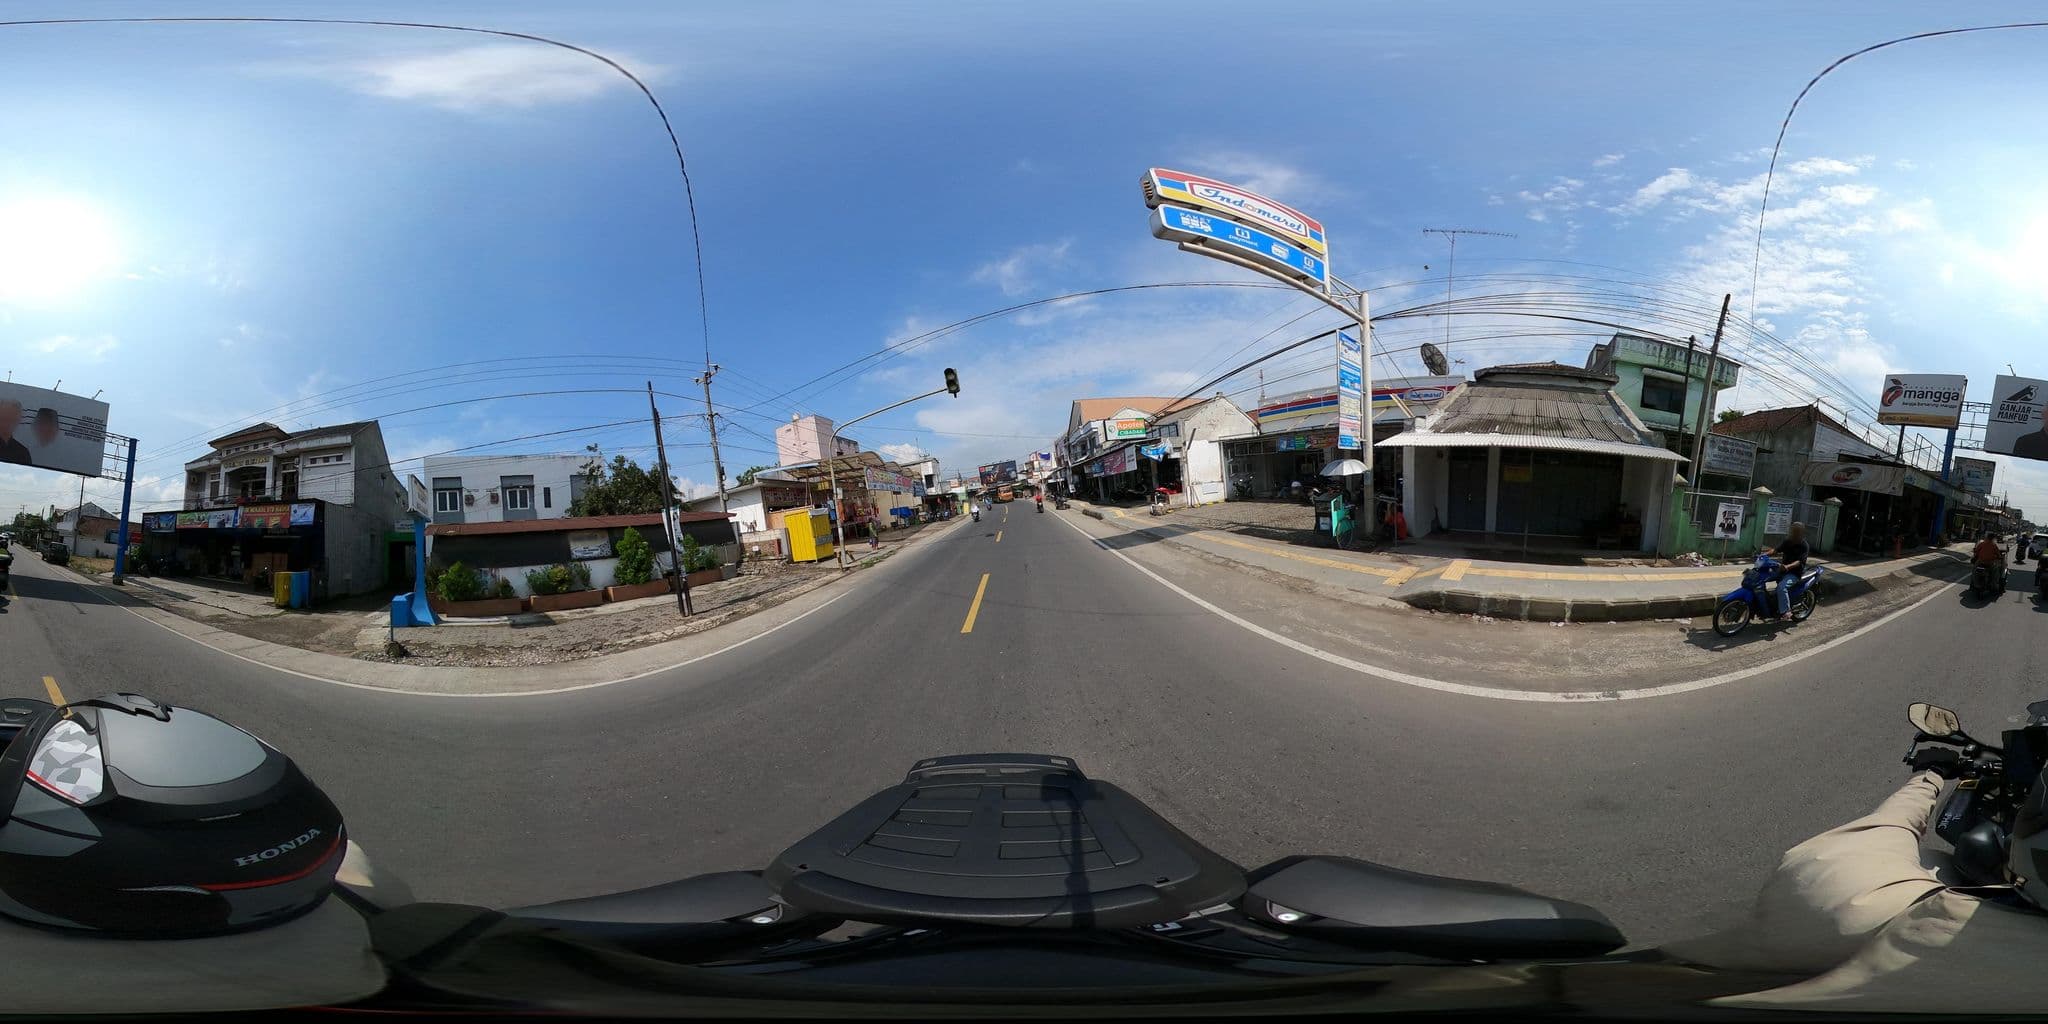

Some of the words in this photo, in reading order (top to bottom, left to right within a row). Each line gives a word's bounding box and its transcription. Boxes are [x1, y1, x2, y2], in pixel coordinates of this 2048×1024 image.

[1199, 187, 1303, 233] Indomaret
[1903, 389, 1959, 403] mangga
[2000, 403, 2032, 414] GANJAR
[1997, 411, 2029, 421] MAHFUD
[1117, 420, 1144, 430] Apotek
[232, 828, 321, 867] HONDA
